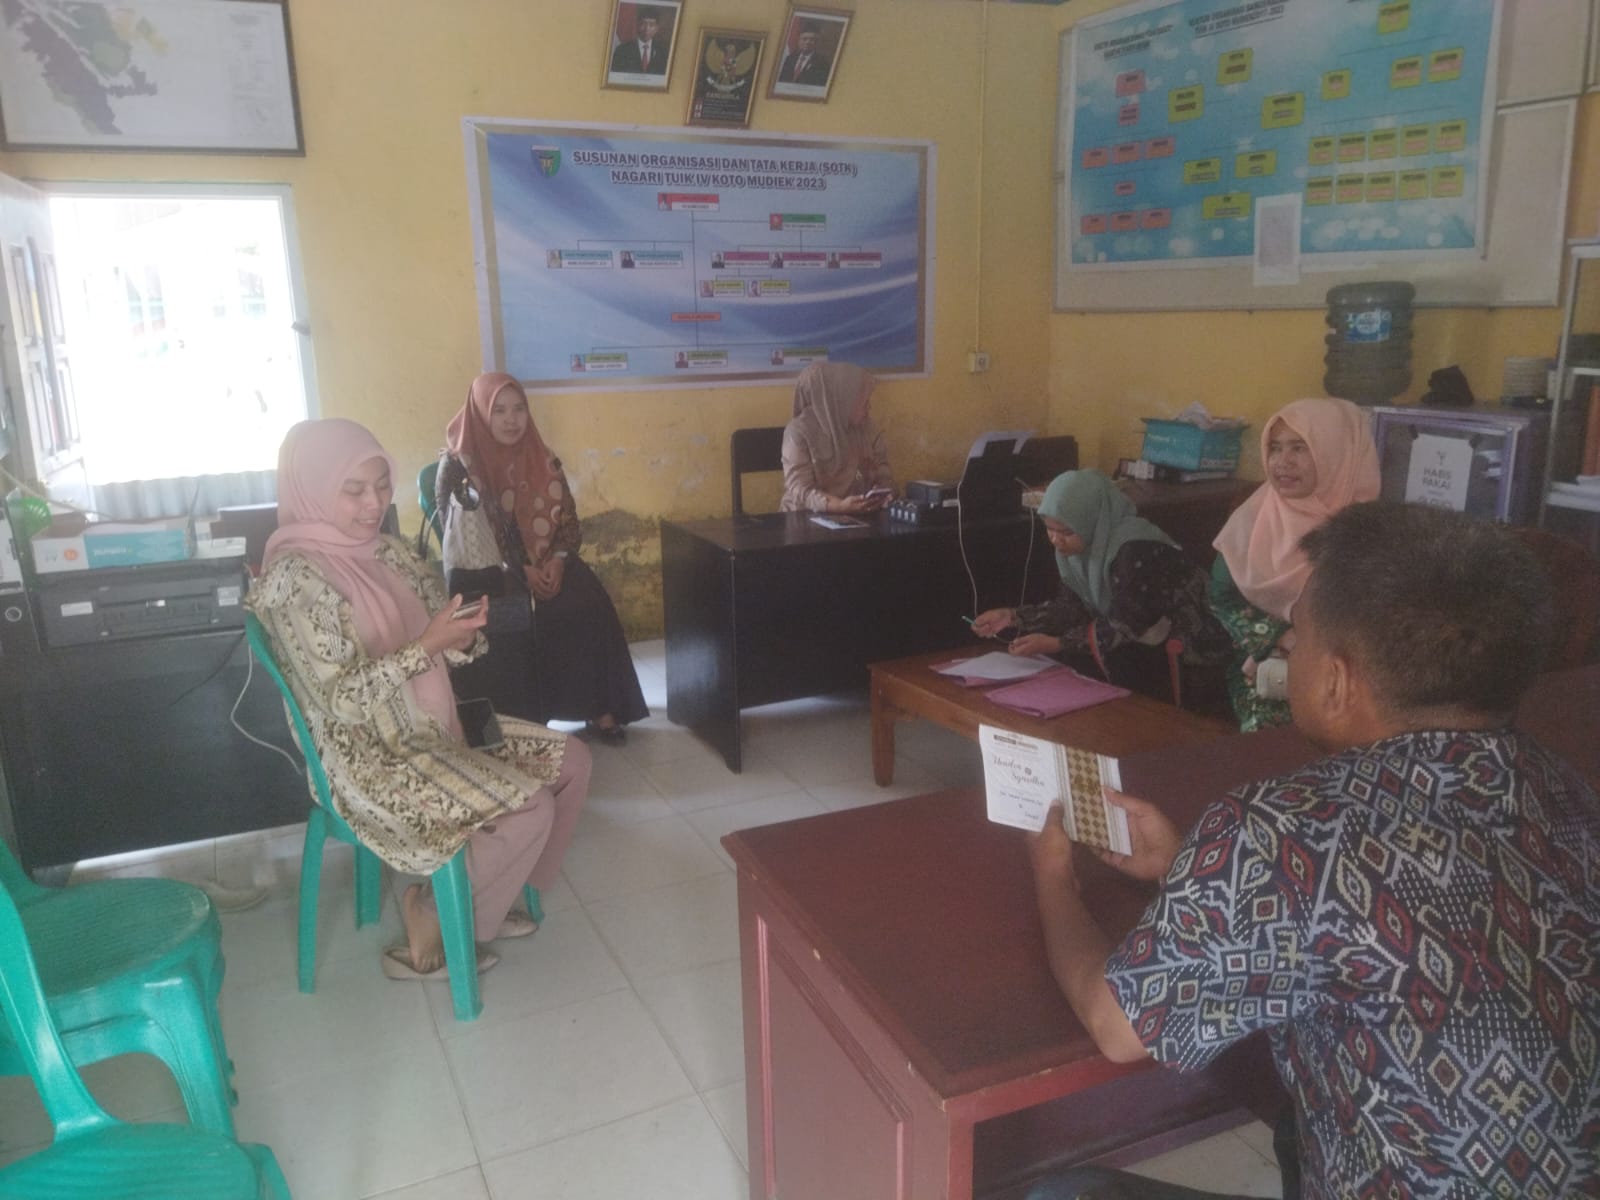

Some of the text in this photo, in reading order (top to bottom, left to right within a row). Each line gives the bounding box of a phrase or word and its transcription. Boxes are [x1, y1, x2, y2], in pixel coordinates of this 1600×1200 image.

[573, 151, 858, 177] SUSUNAN ORGANISASI DAN TATA KERJA (SOTK)
[611, 171, 663, 185] NAGARI
[697, 174, 710, 187] IV
[712, 175, 746, 188] KOTO
[747, 175, 793, 189] MUDIEK
[796, 178, 827, 190] 2023
